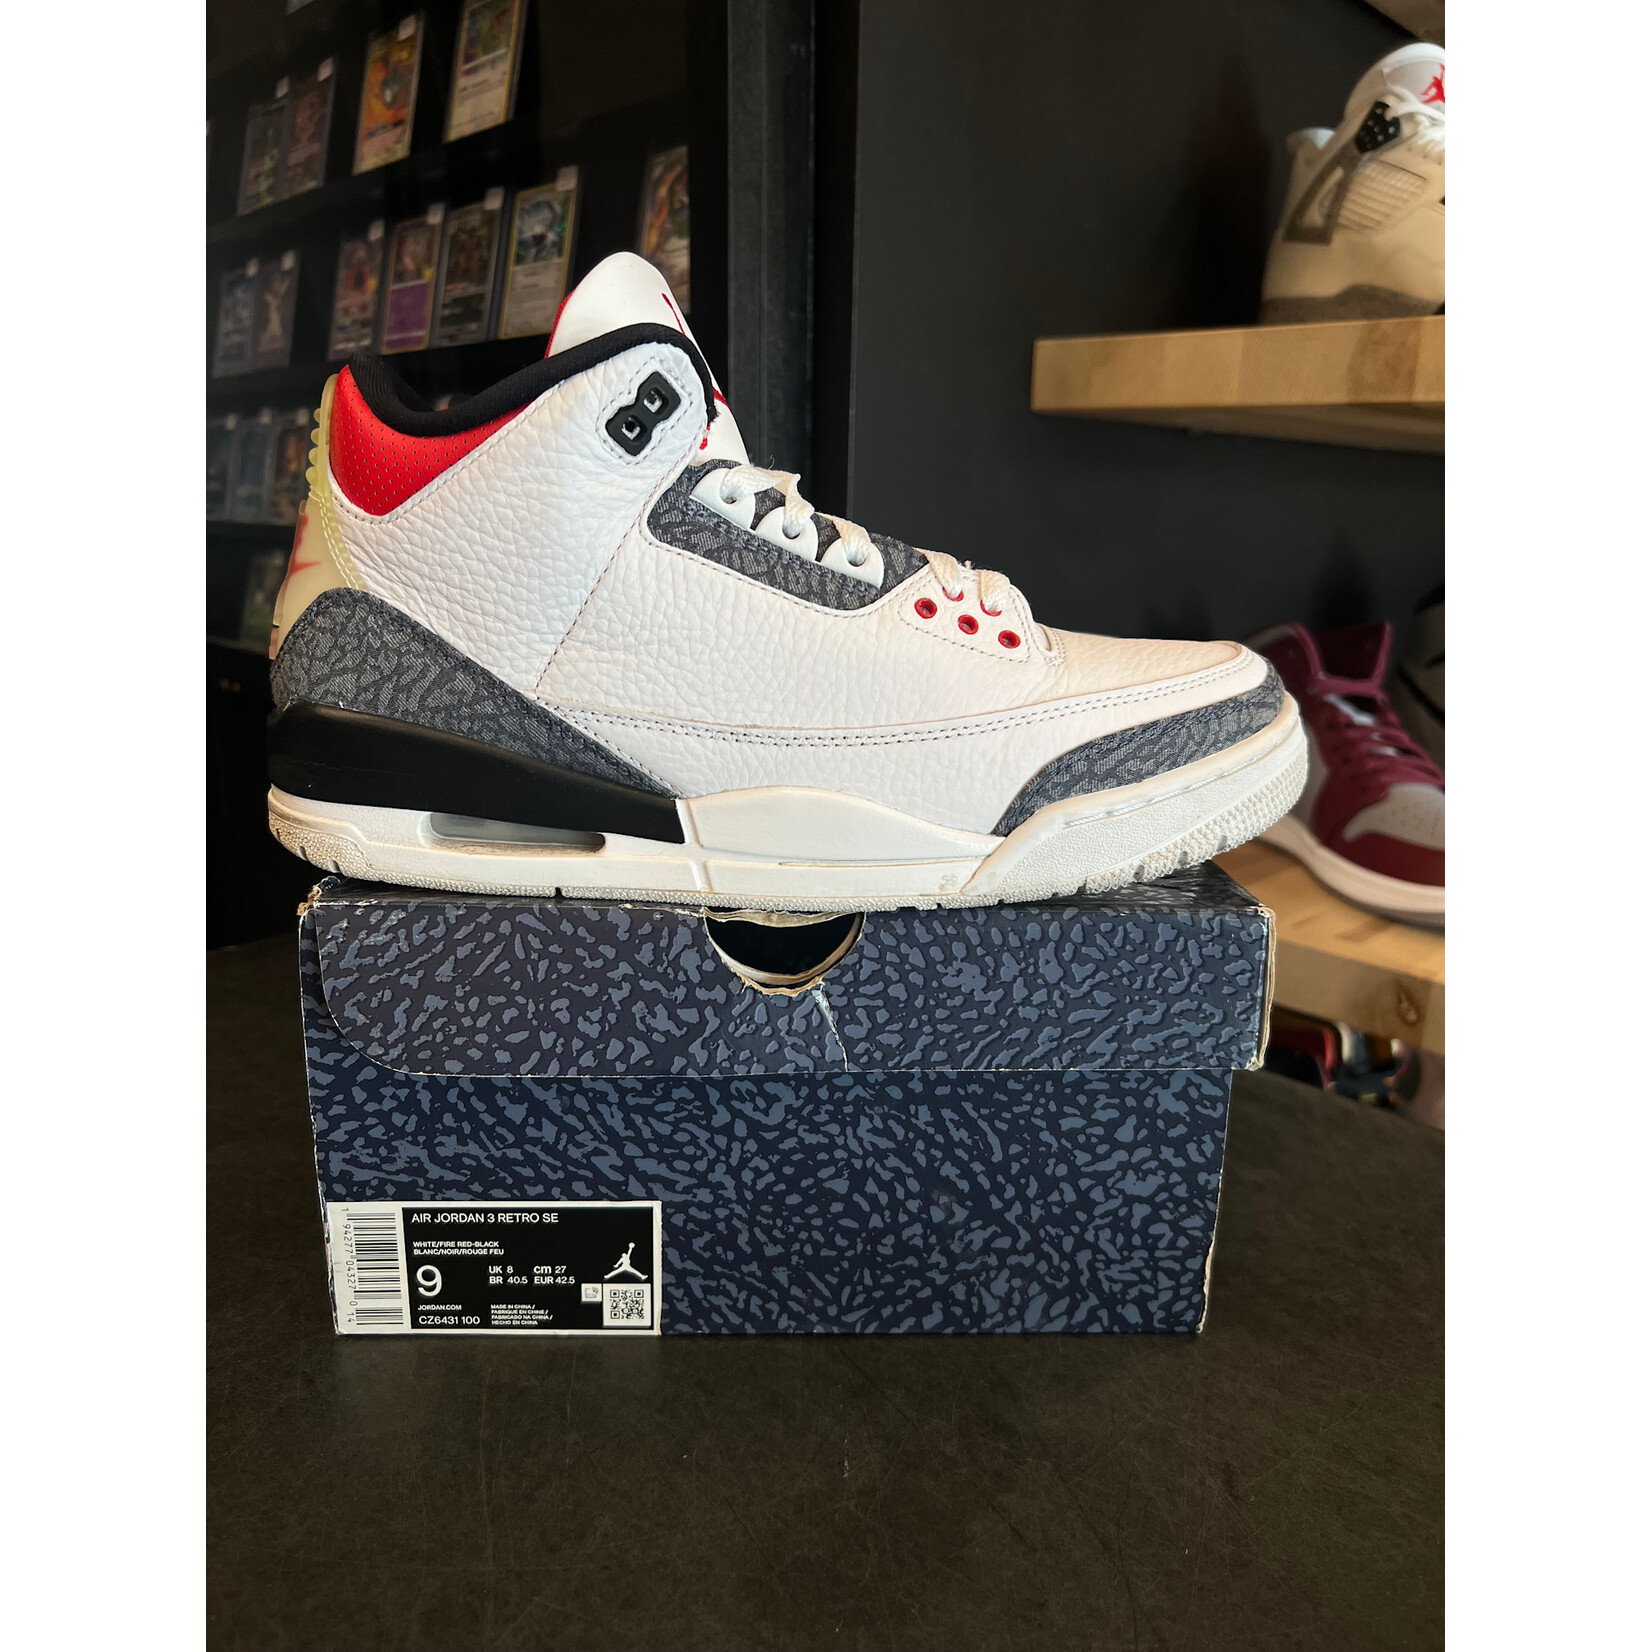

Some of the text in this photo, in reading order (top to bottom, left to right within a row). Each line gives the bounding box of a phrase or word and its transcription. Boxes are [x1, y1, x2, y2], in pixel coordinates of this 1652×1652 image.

[411, 1212, 559, 1223] AIR JORDAN 3 RETRO SE
[342, 1223, 354, 1254] 94277
[345, 1260, 357, 1290] 04327
[489, 1265, 567, 1274] UK 8 cm 27
[416, 1264, 442, 1297] 9
[489, 1276, 575, 1284] BR 40.5 EUR 42.5
[418, 1315, 480, 1325] CZ6431 100
